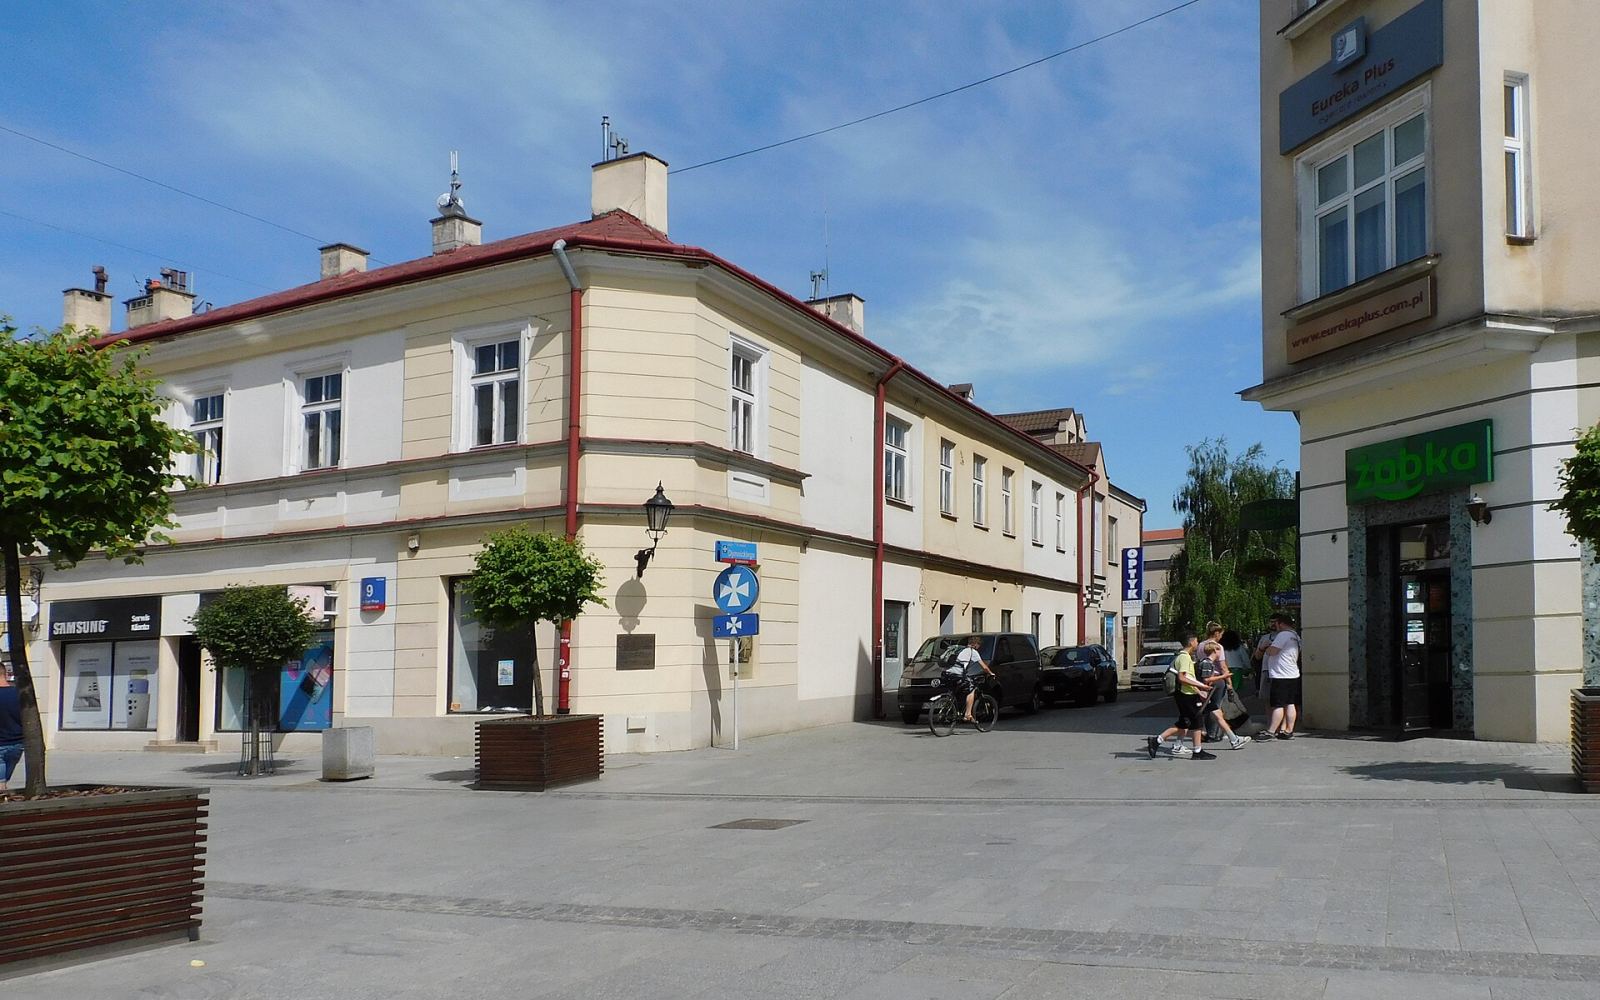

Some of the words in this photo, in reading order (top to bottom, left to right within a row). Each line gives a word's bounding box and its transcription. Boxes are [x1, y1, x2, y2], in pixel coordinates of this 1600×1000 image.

[1312, 80, 1360, 117] Eureka
[1364, 58, 1394, 86] Plus
[1291, 291, 1424, 348] www.eurekaplus.com.pl
[366, 584, 374, 597] 9
[1127, 548, 1139, 600] OPTYK
[53, 620, 108, 635] SAMSUNG
